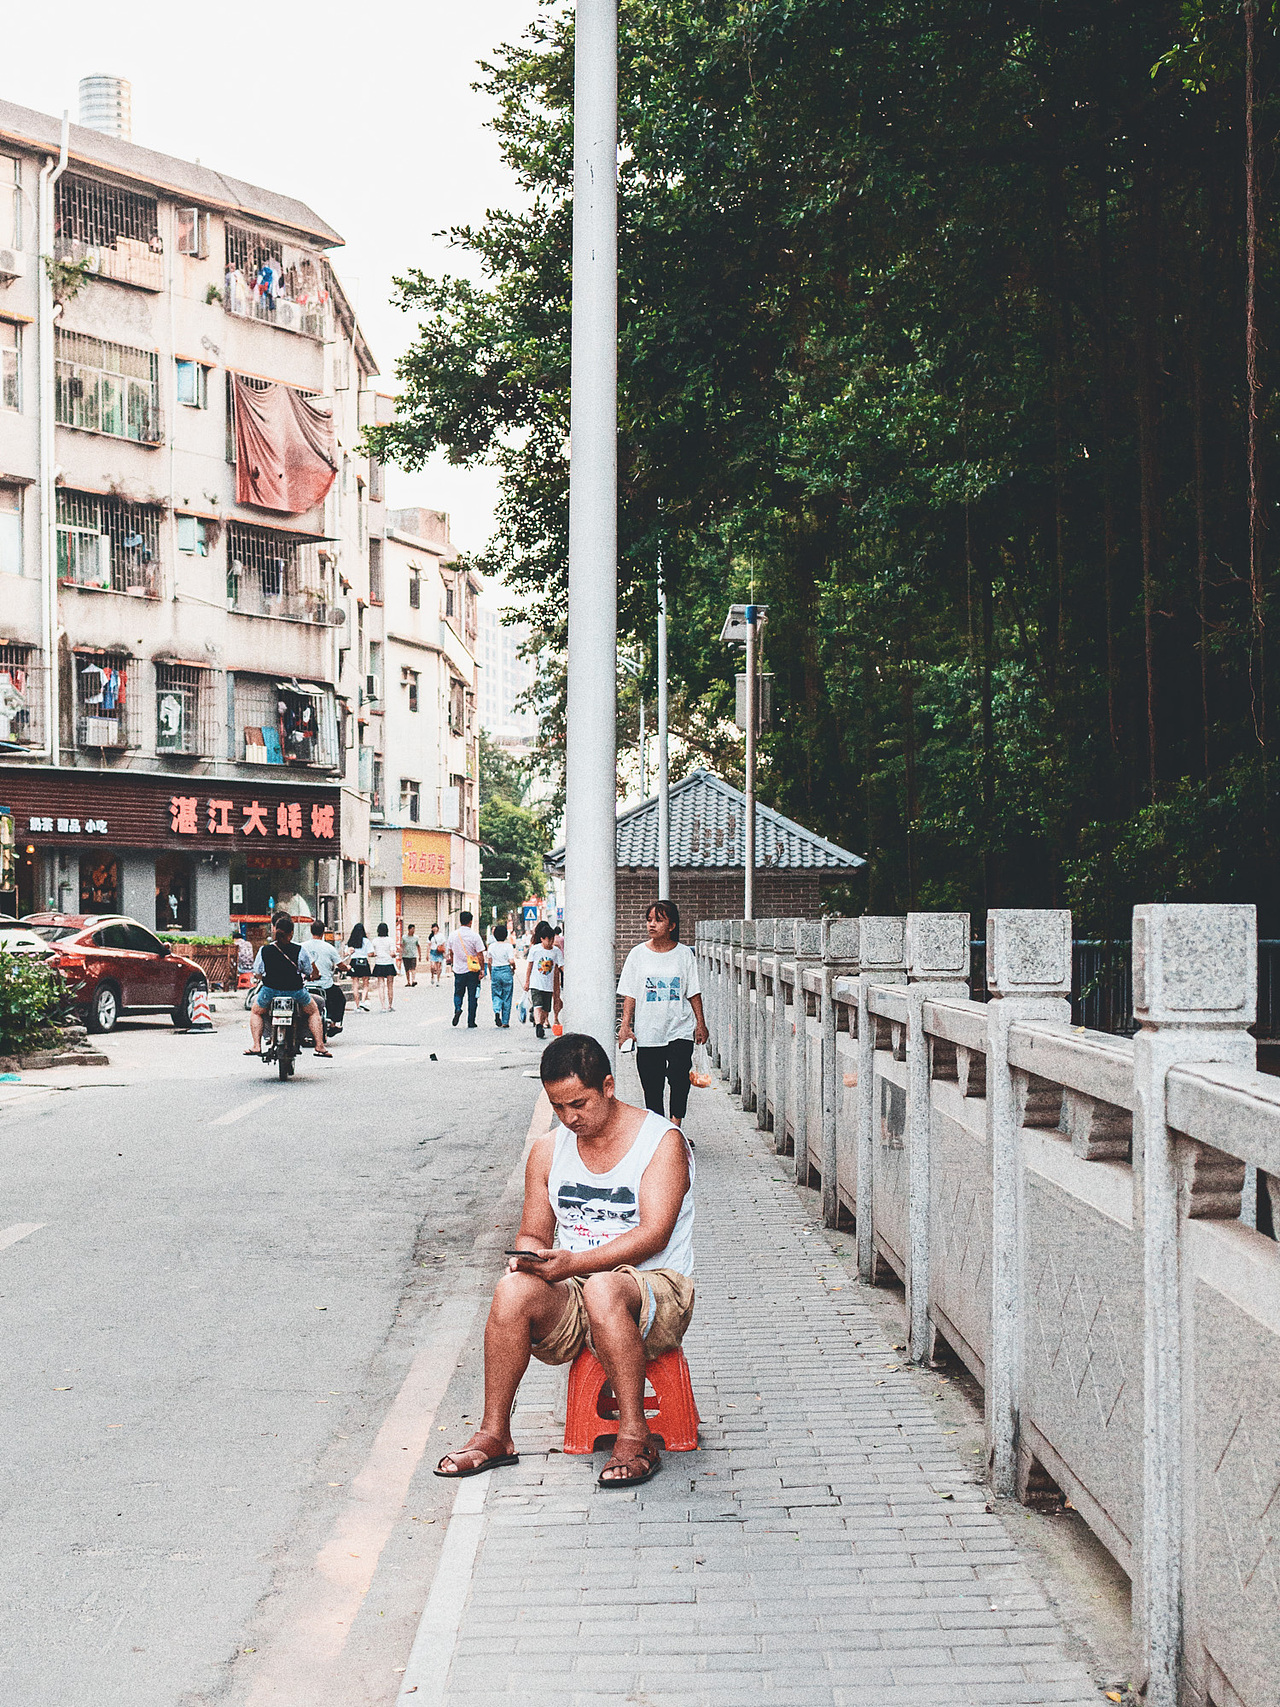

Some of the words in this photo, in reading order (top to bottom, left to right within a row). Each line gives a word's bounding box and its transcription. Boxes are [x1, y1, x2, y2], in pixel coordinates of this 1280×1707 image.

[85, 818, 108, 834] 小吃
[169, 796, 335, 839] 湛江大蚝城
